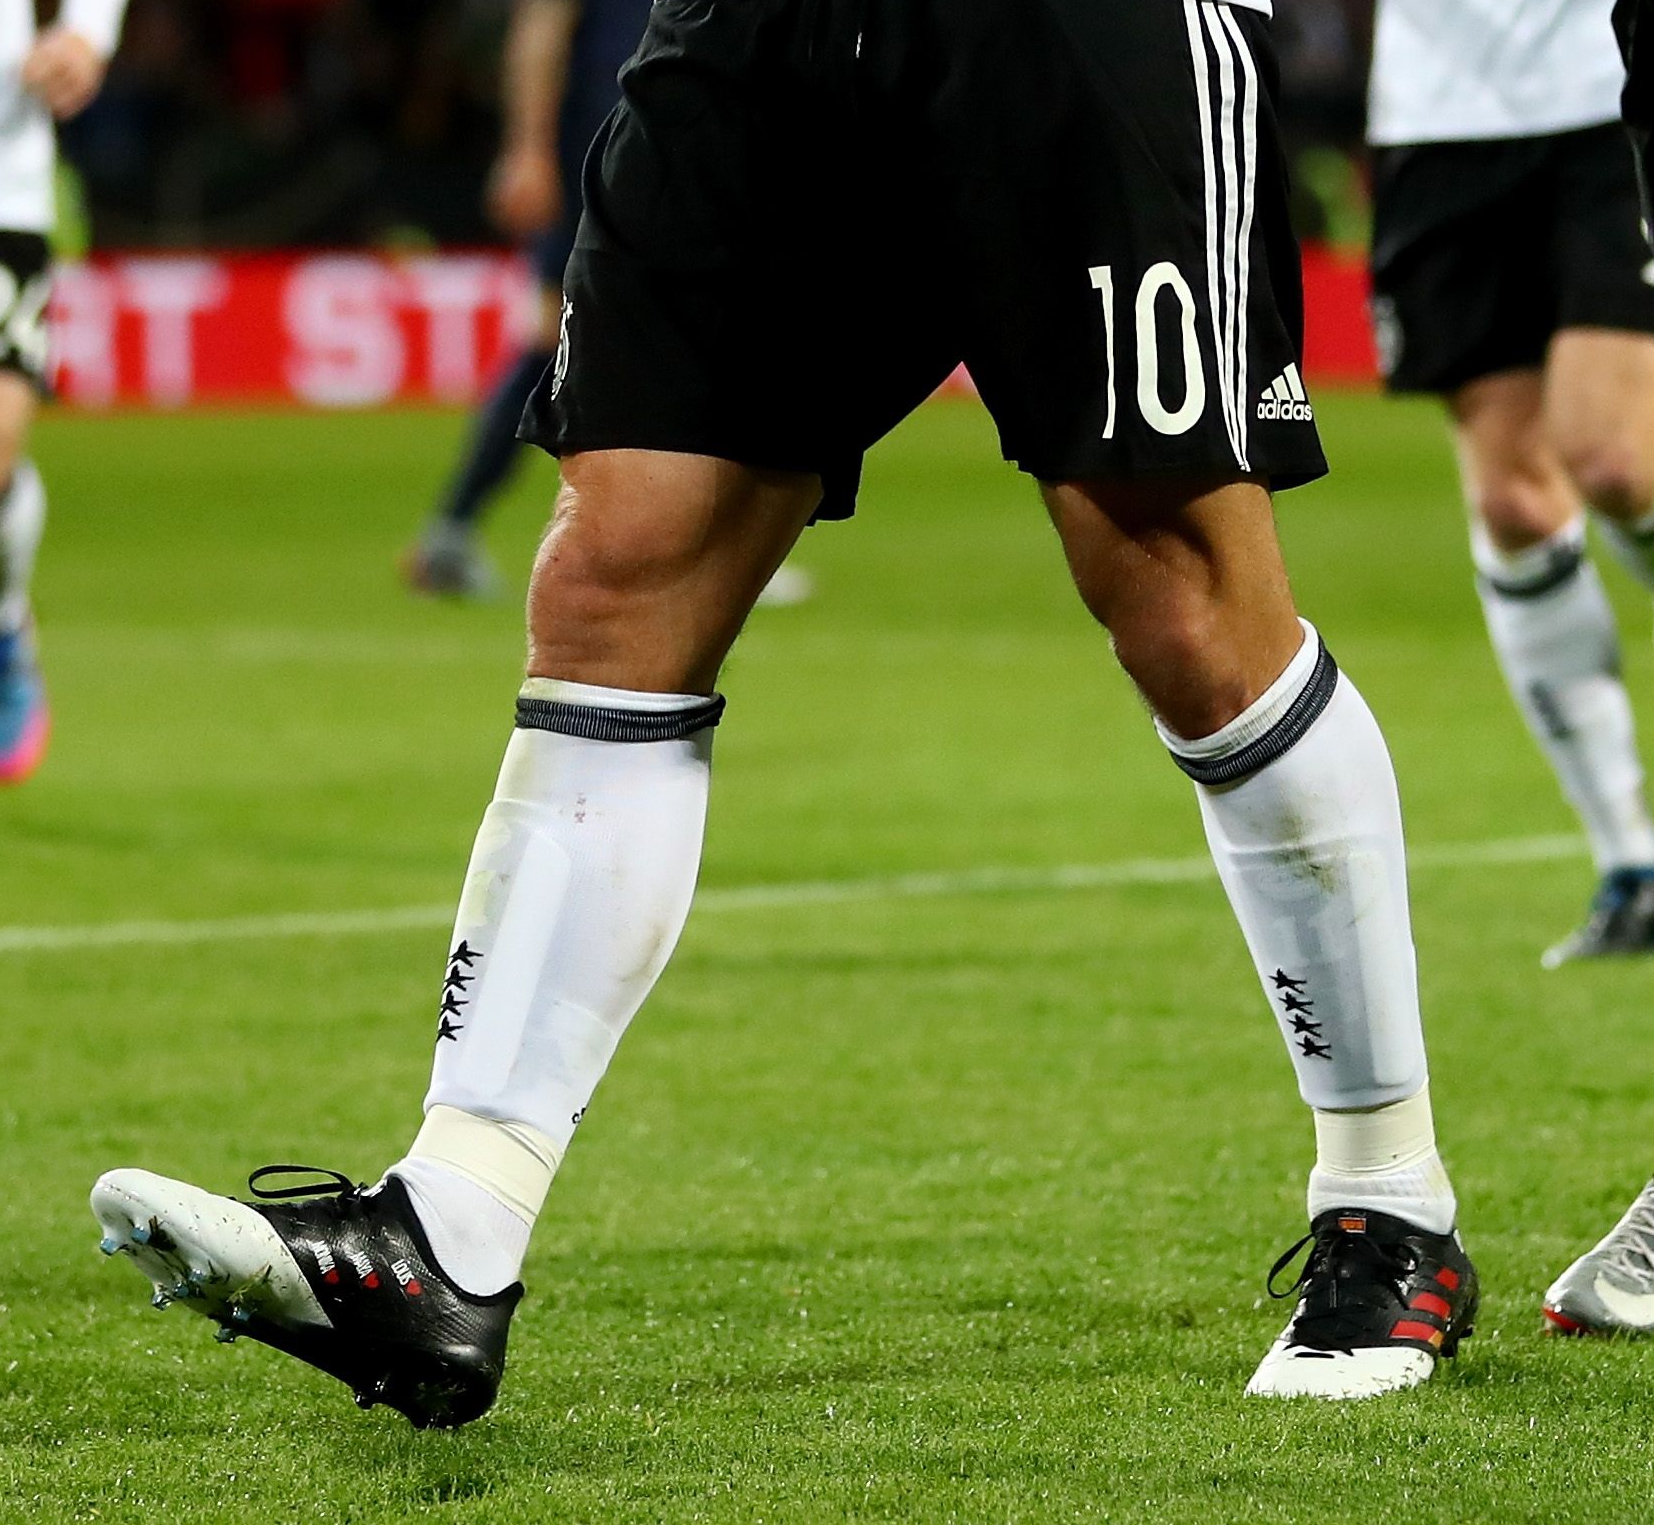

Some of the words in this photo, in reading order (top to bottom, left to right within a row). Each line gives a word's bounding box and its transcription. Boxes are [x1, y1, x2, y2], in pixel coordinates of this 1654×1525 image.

[1088, 261, 1206, 439] 10
[1257, 398, 1313, 421] adidas
[391, 1259, 415, 1286] LOUIS
